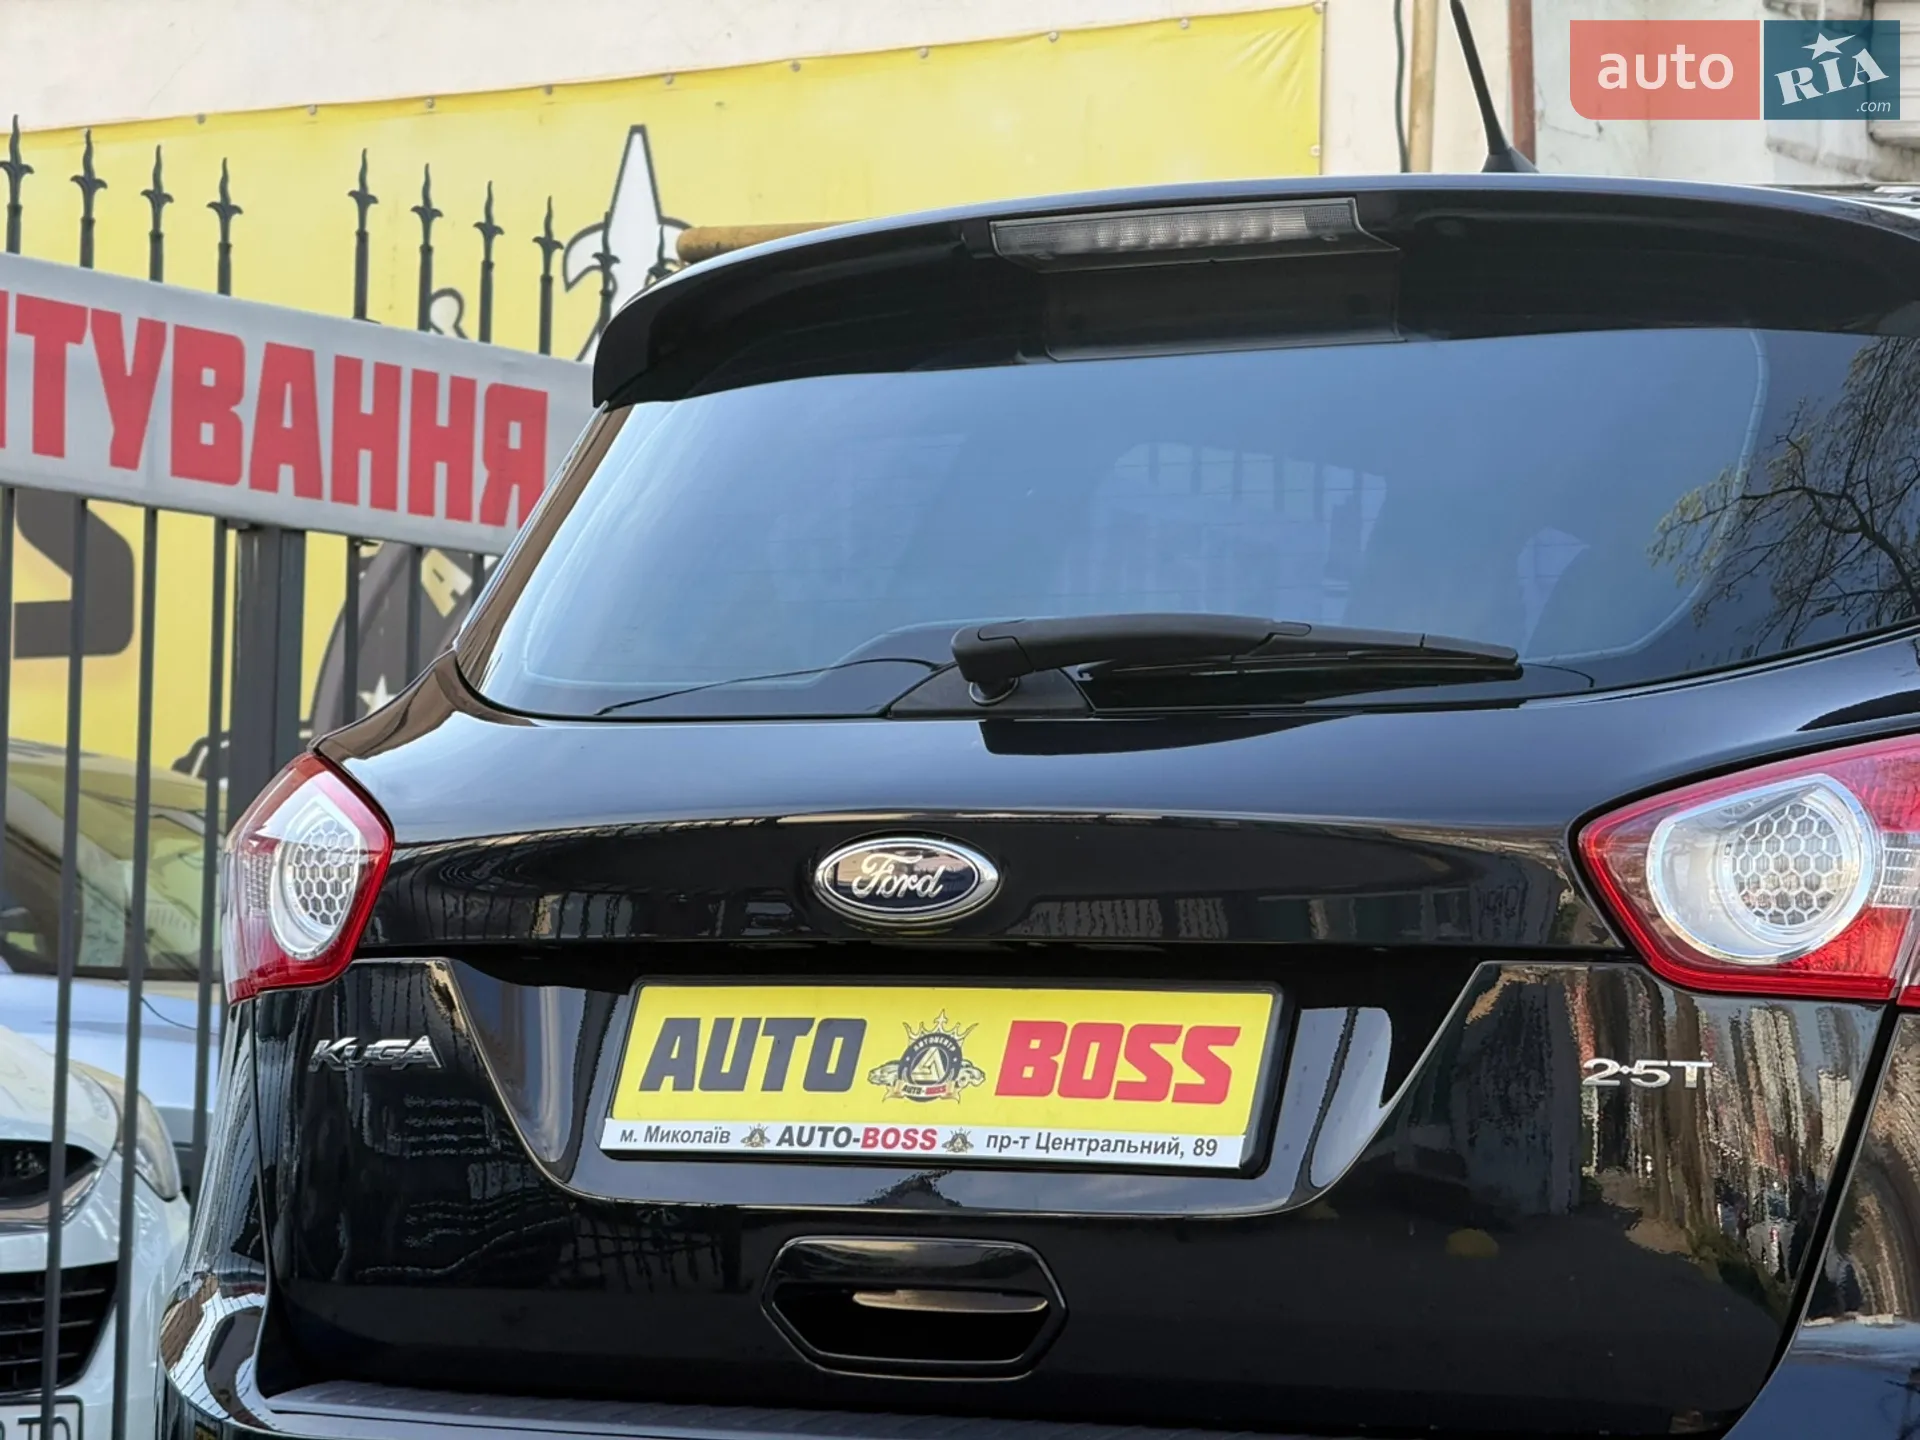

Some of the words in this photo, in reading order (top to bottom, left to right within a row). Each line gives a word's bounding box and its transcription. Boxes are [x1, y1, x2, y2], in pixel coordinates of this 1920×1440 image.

[0, 289, 548, 529] ТУВАННЯ
[851, 852, 944, 899] Ford
[308, 1035, 443, 1072] KUGA
[638, 1016, 868, 1093] AUTO
[994, 1020, 1242, 1106] BOSS
[619, 1129, 638, 1144] м.
[643, 1125, 731, 1145] Миколаїв
[776, 1125, 939, 1151] AUTO-BOSS
[985, 1132, 1031, 1153] пр-т
[1034, 1131, 1185, 1160] Центральний,
[1192, 1137, 1219, 1158] 89
